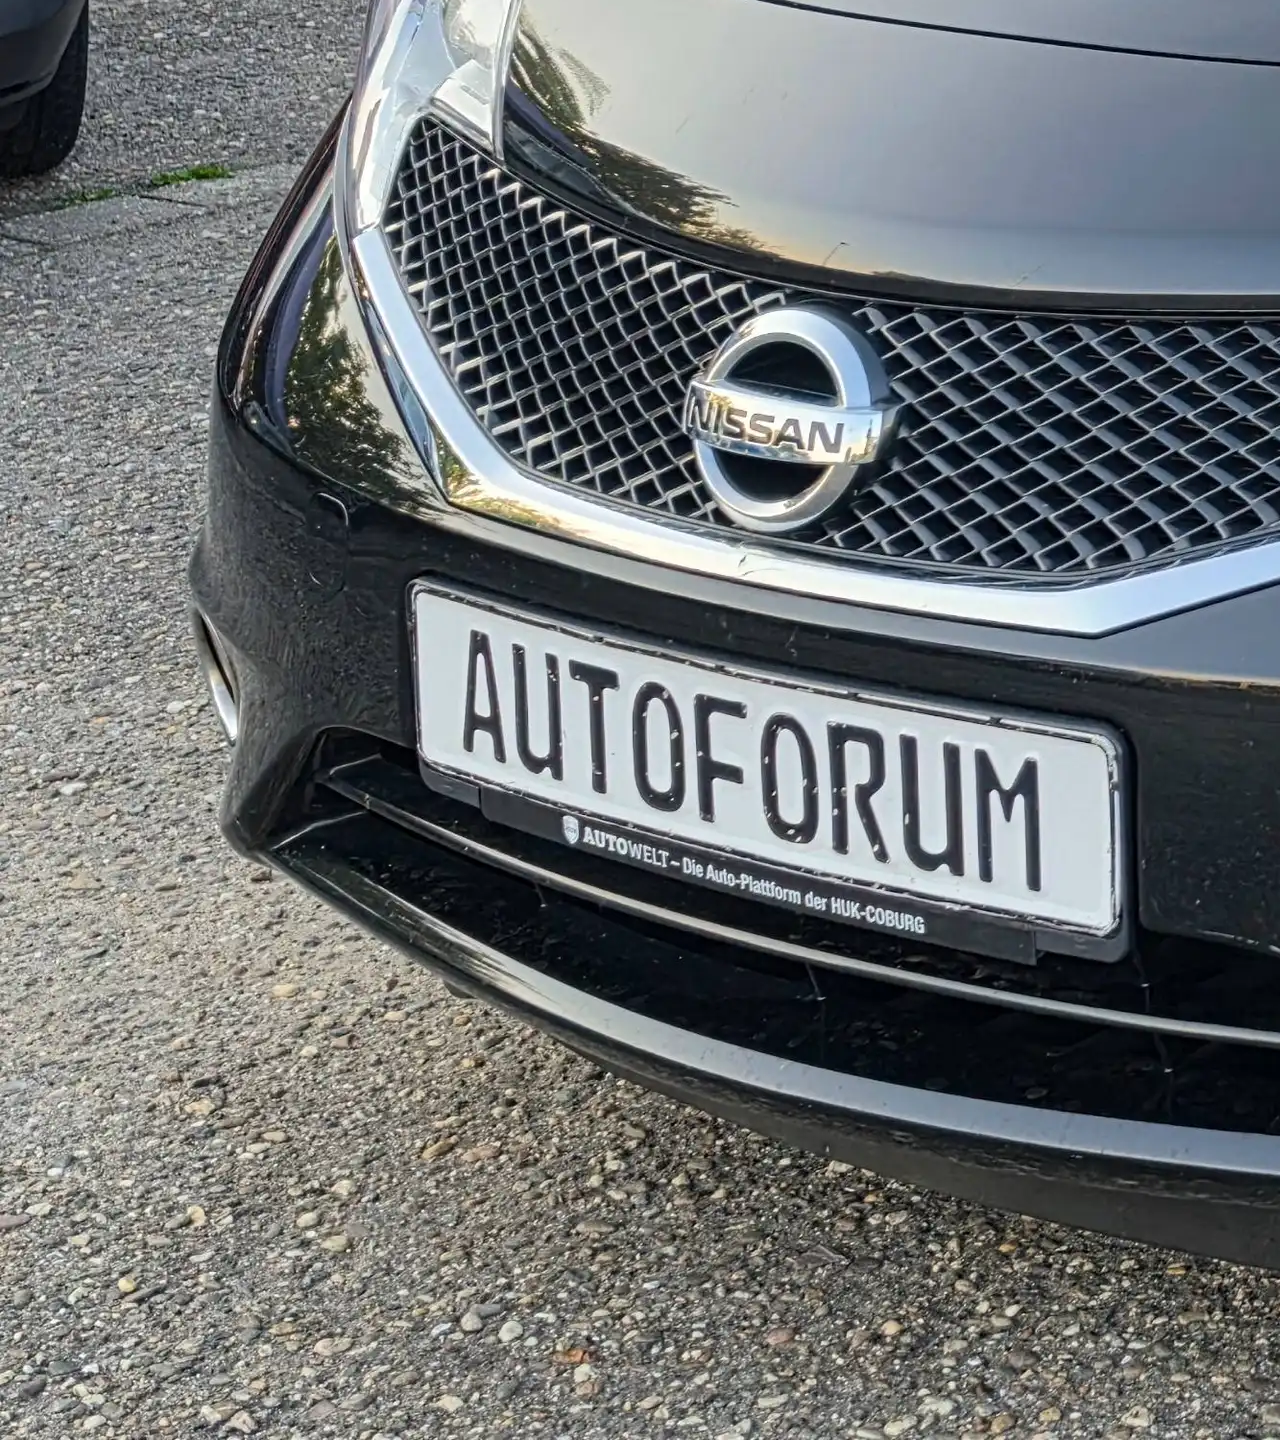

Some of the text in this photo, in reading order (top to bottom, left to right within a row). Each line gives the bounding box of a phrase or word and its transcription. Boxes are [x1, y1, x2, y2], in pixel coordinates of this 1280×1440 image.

[687, 392, 845, 454] NISSAN
[462, 628, 1042, 893] AUTOFORUM
[582, 825, 669, 869] AUTOWELT
[682, 856, 704, 879] Die
[705, 863, 802, 905] Auto-Plattform
[804, 890, 828, 912] der
[831, 895, 926, 935] HUK-COBURG
